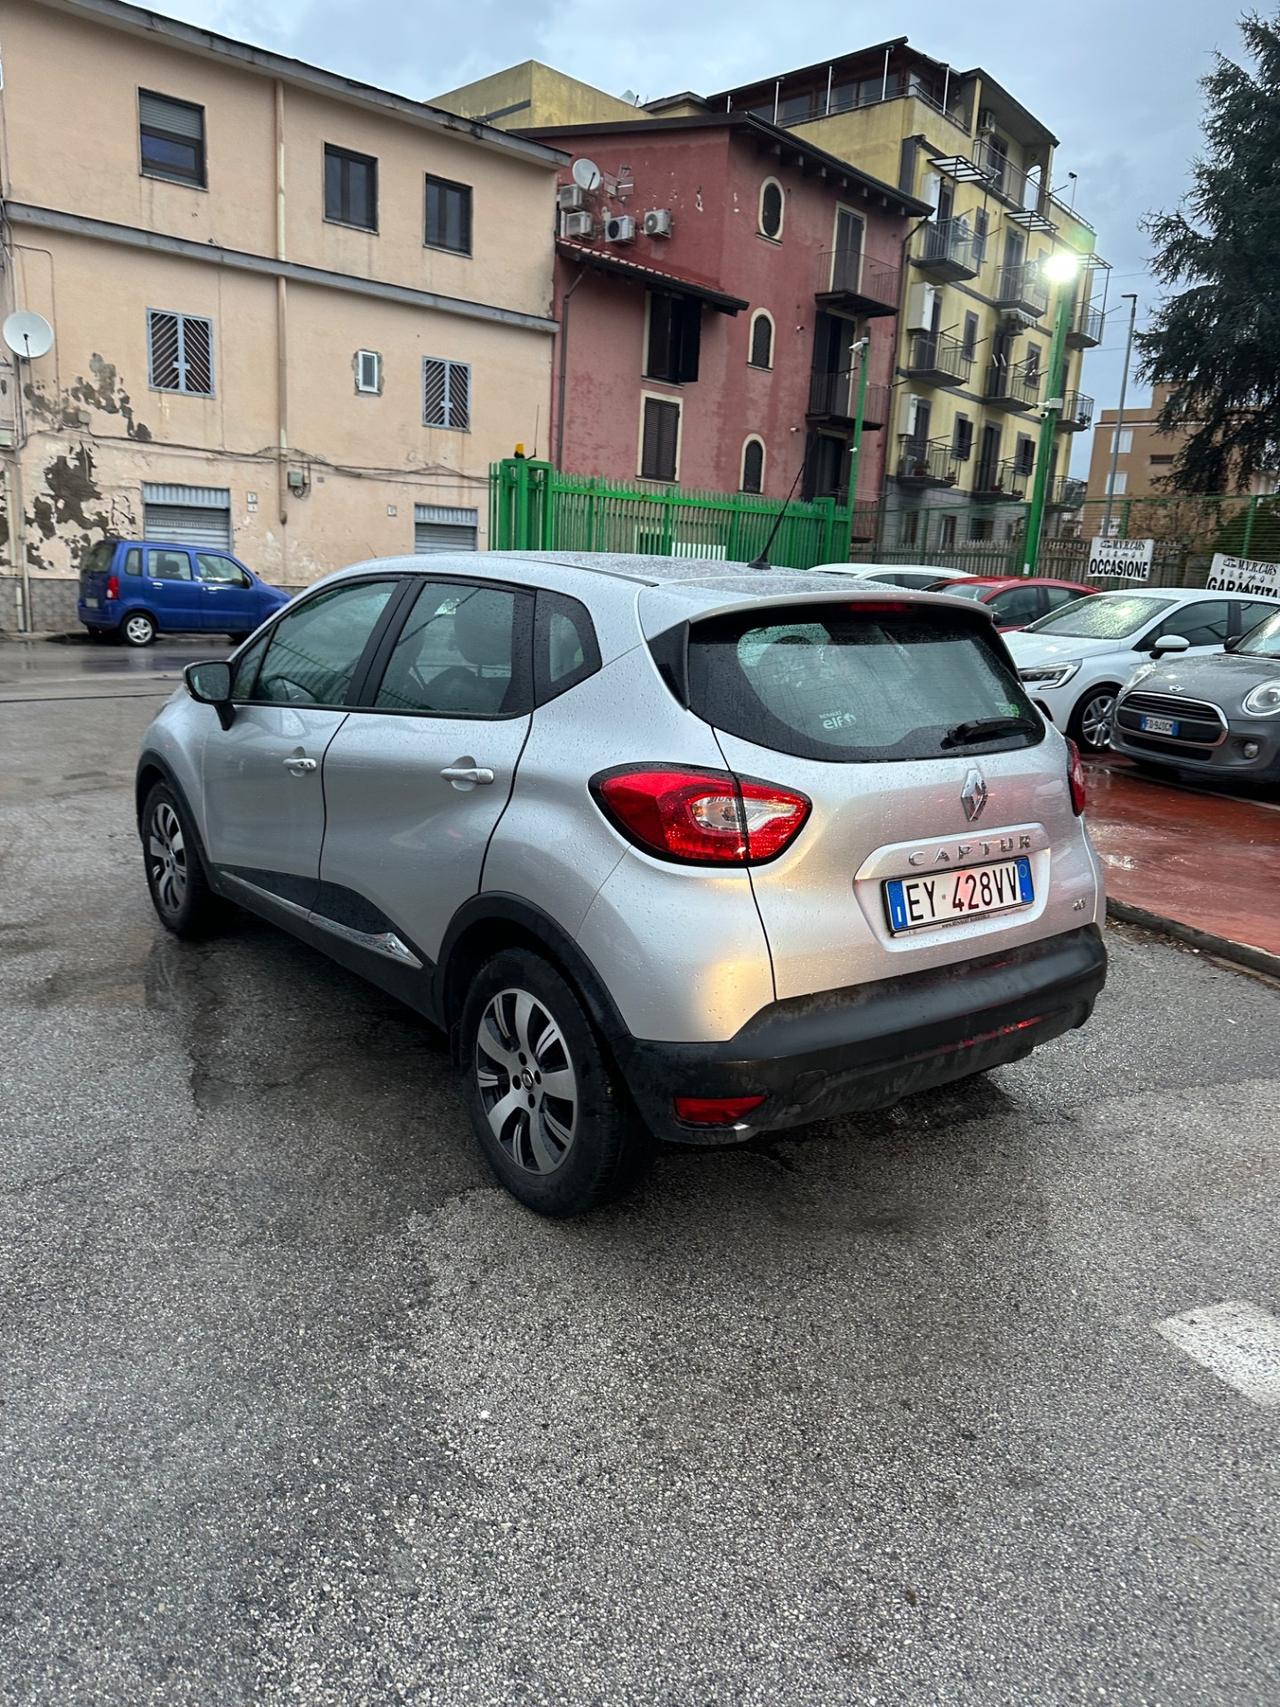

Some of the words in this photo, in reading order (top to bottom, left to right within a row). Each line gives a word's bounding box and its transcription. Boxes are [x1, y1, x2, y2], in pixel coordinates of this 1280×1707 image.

[1090, 558, 1148, 578] OCCASIONE
[823, 716, 843, 729] elf
[908, 835, 1031, 867] CAPTUR
[906, 880, 936, 922] EY
[952, 866, 1017, 912] 428VV
